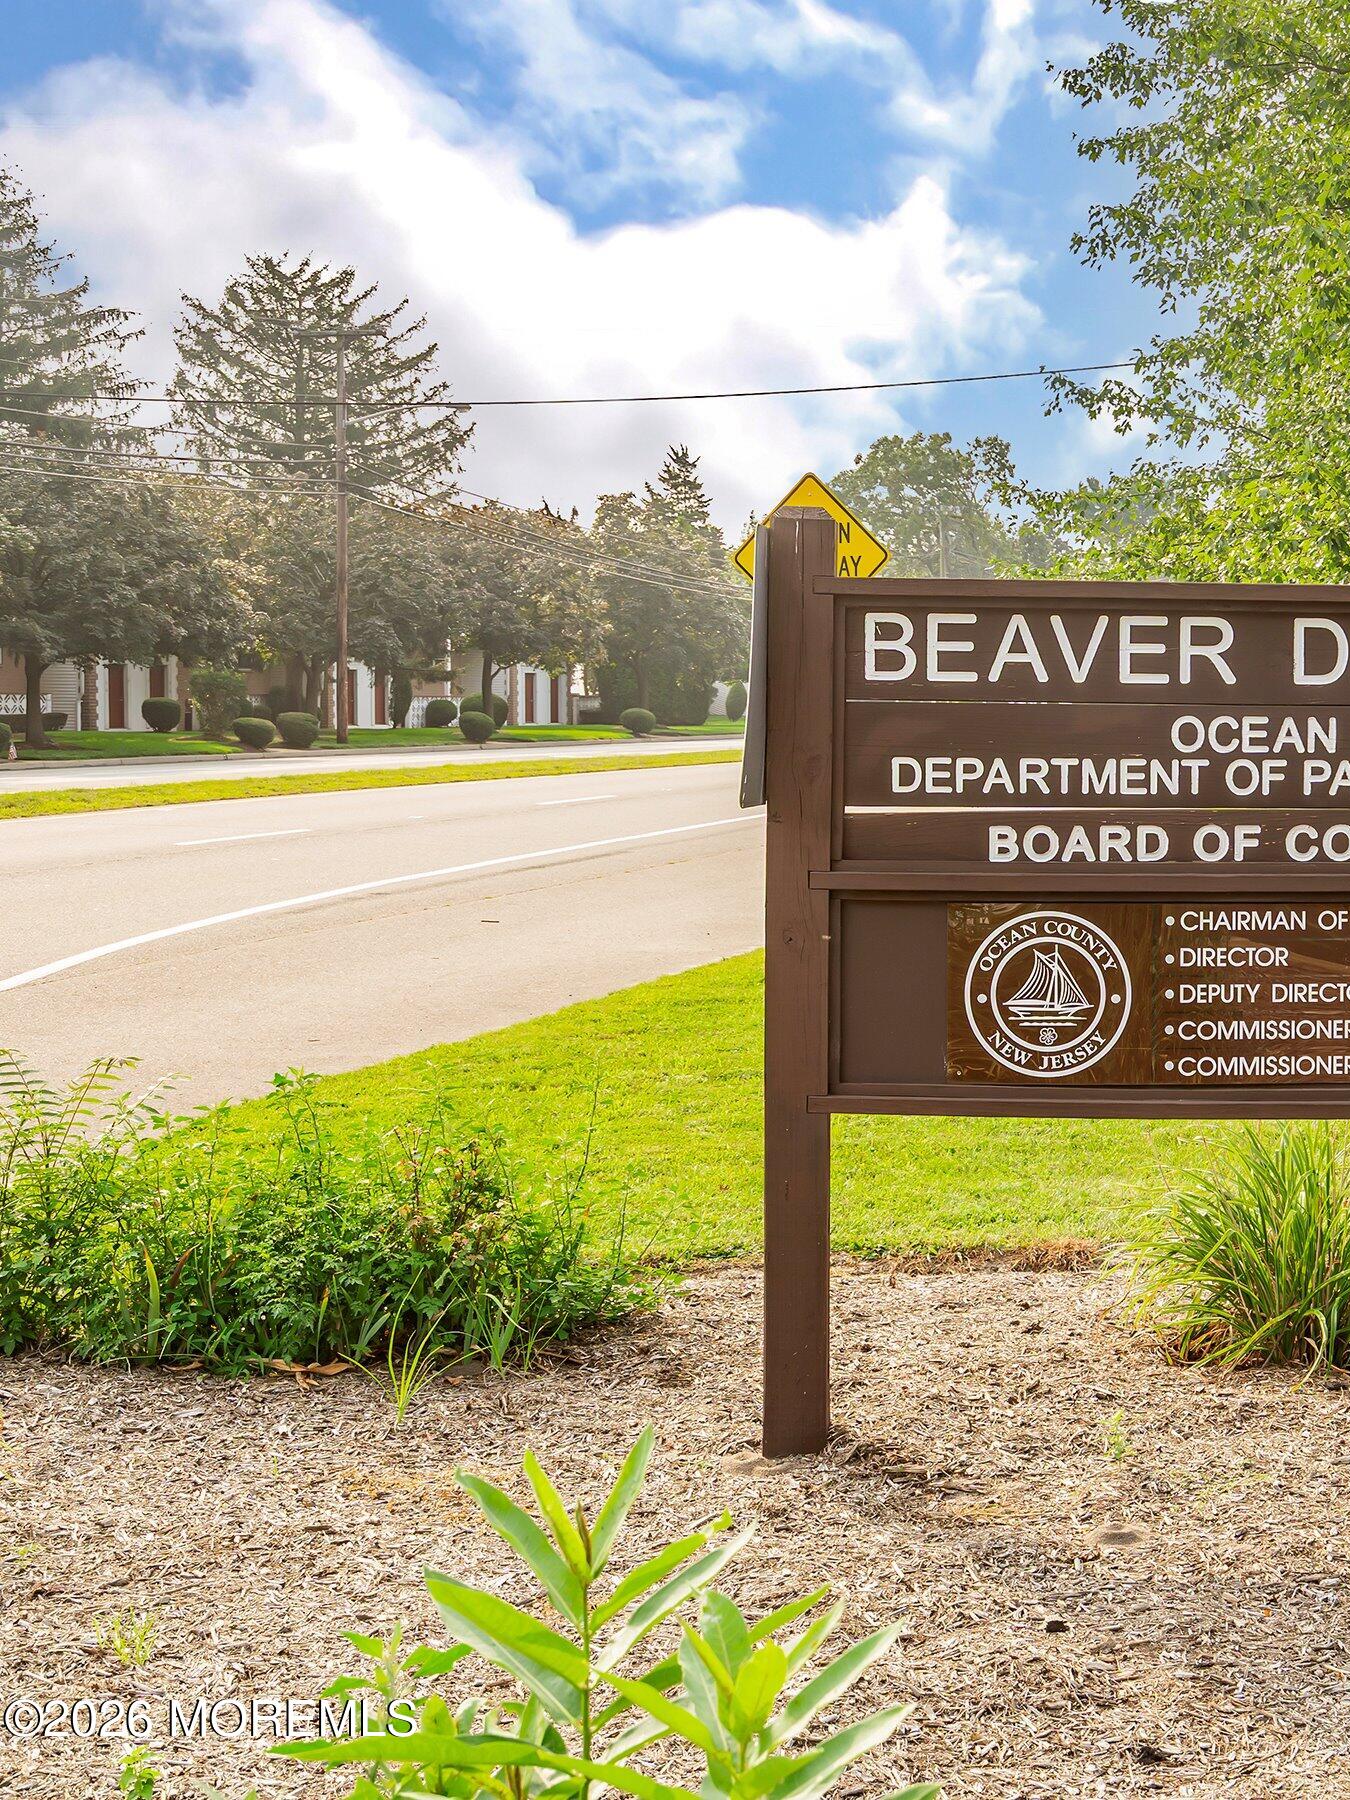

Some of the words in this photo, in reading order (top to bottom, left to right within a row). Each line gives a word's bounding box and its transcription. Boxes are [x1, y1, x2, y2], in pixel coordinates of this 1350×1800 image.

[864, 612, 1237, 685] BEAVER
[1170, 715, 1337, 754] OCEAN
[891, 756, 1210, 795] DEPARTMENT
[1225, 758, 1288, 796] OF
[988, 825, 1170, 863] BOARD
[1193, 824, 1262, 862] OF
[1180, 910, 1306, 931] CHAIRMAN
[1317, 910, 1349, 931] OF
[979, 921, 1037, 972] OCEAN
[1043, 920, 1118, 971] COUNTY
[1179, 946, 1289, 967] DIRECTOR
[1179, 983, 1261, 1004] DEPUTY
[987, 1030, 1033, 1066] NEW
[1038, 1031, 1107, 1071] JERSEY
